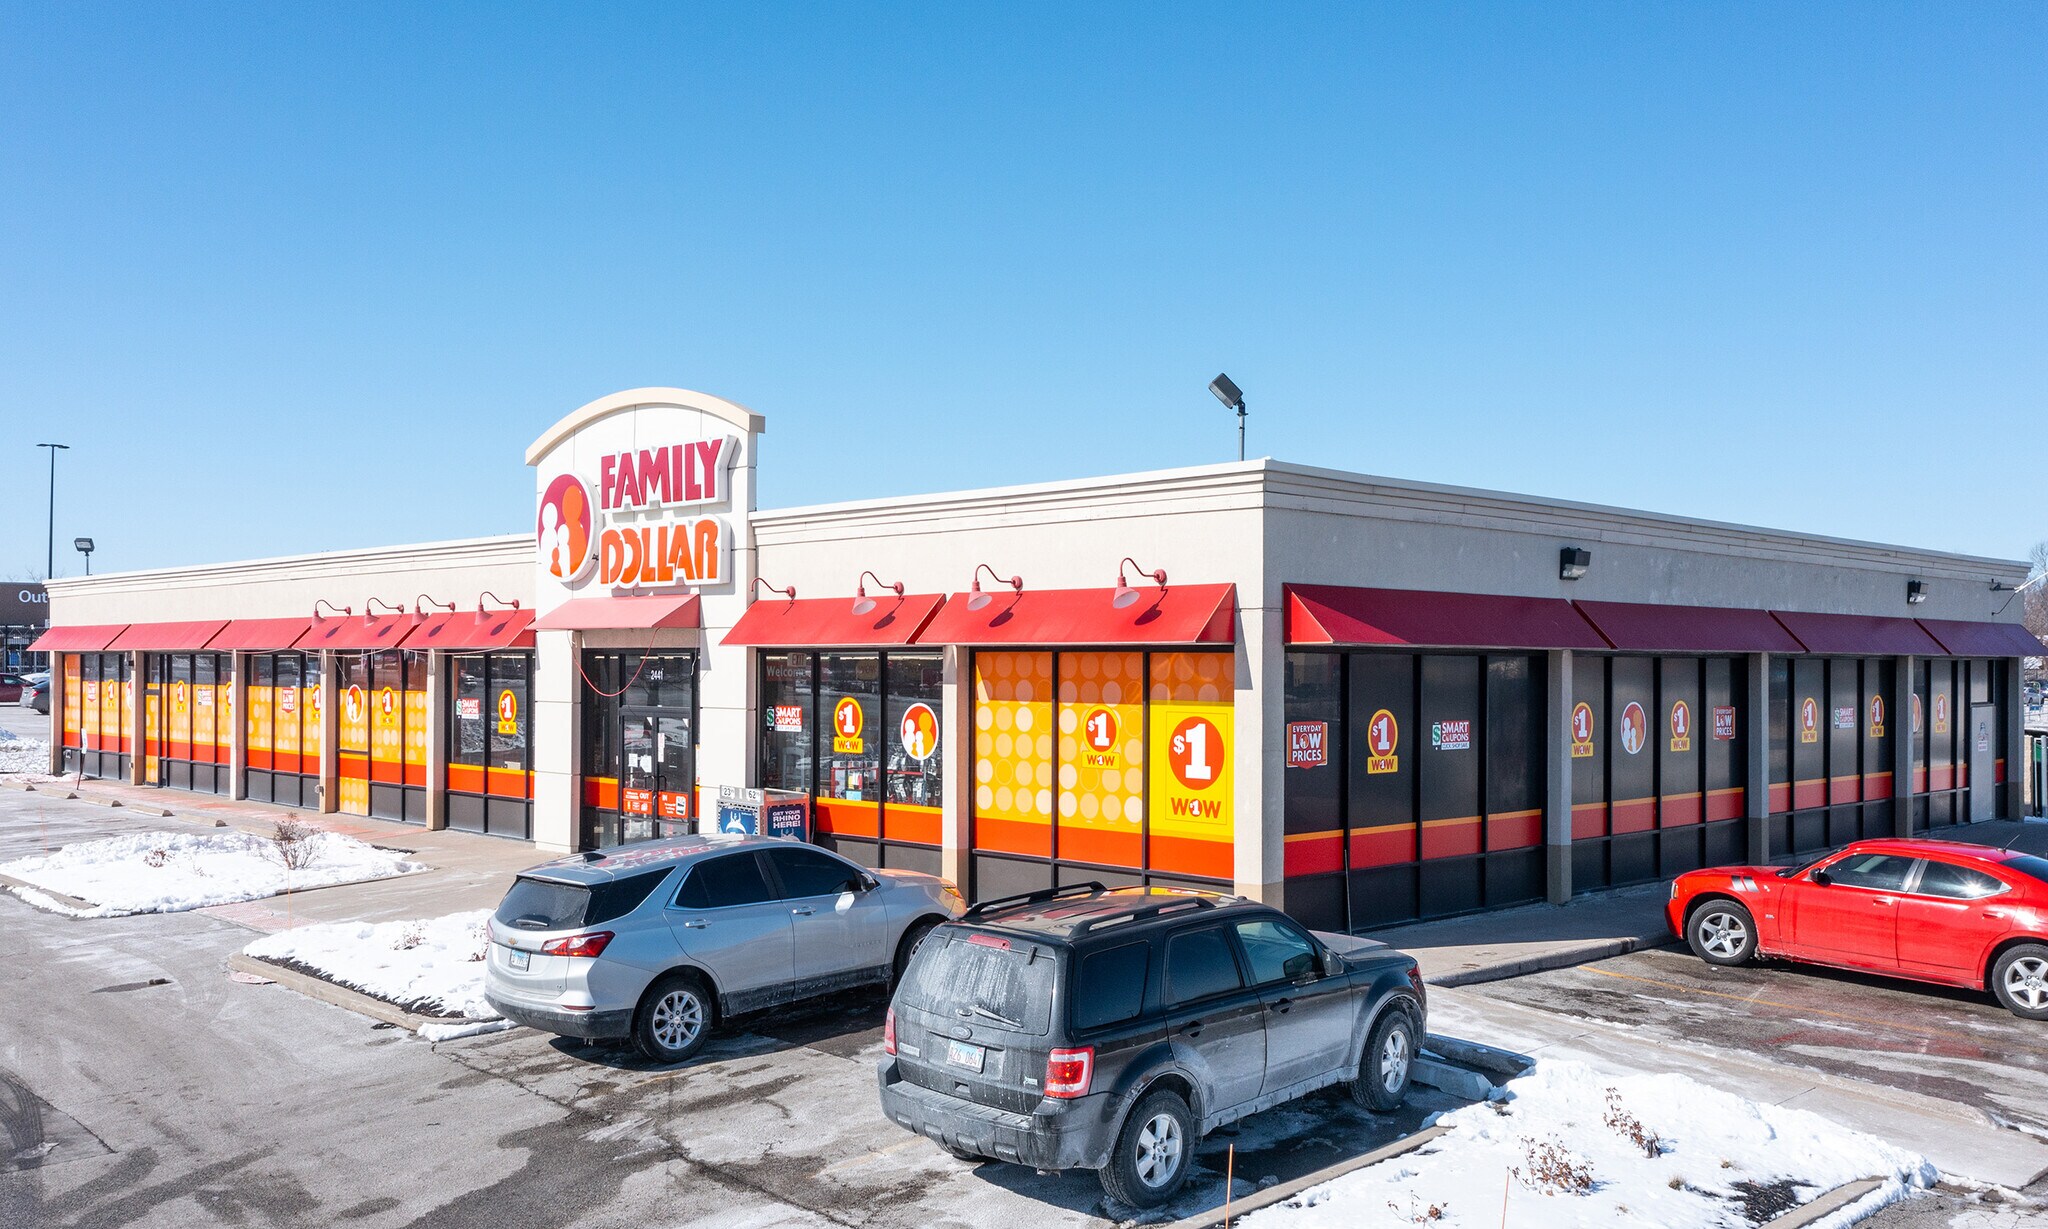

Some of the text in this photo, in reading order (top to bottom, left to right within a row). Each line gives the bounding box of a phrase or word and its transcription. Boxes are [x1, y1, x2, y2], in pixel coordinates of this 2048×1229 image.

[600, 438, 723, 510] FAMILY
[600, 519, 719, 585] DOLLAR
[18, 589, 48, 603] Out
[501, 695, 513, 718] $1
[775, 707, 801, 718] SMART
[1872, 700, 1881, 722] $1
[775, 717, 801, 725] COUPONS
[838, 704, 855, 733] $1
[1673, 706, 1685, 734] $1
[1716, 715, 1732, 727] LOW
[1804, 702, 1813, 727] $1
[1088, 712, 1110, 747] $1
[1292, 725, 1322, 733] EVERYDAY
[1442, 721, 1469, 733] SMART
[1574, 709, 1588, 738] $1
[1372, 717, 1390, 750] $1
[1442, 733, 1469, 742] COUPONS
[1716, 727, 1733, 736] PRICES
[838, 740, 859, 750] WOW
[1292, 733, 1322, 749] LOW
[1173, 723, 1211, 780] $1
[1292, 750, 1322, 762] PRICES
[1573, 745, 1591, 755] WOW
[1087, 754, 1115, 767] WOW
[1371, 758, 1394, 771] WOW
[1171, 797, 1221, 819] WOW
[772, 814, 801, 822] RHINO
[772, 820, 801, 829] HERE!
